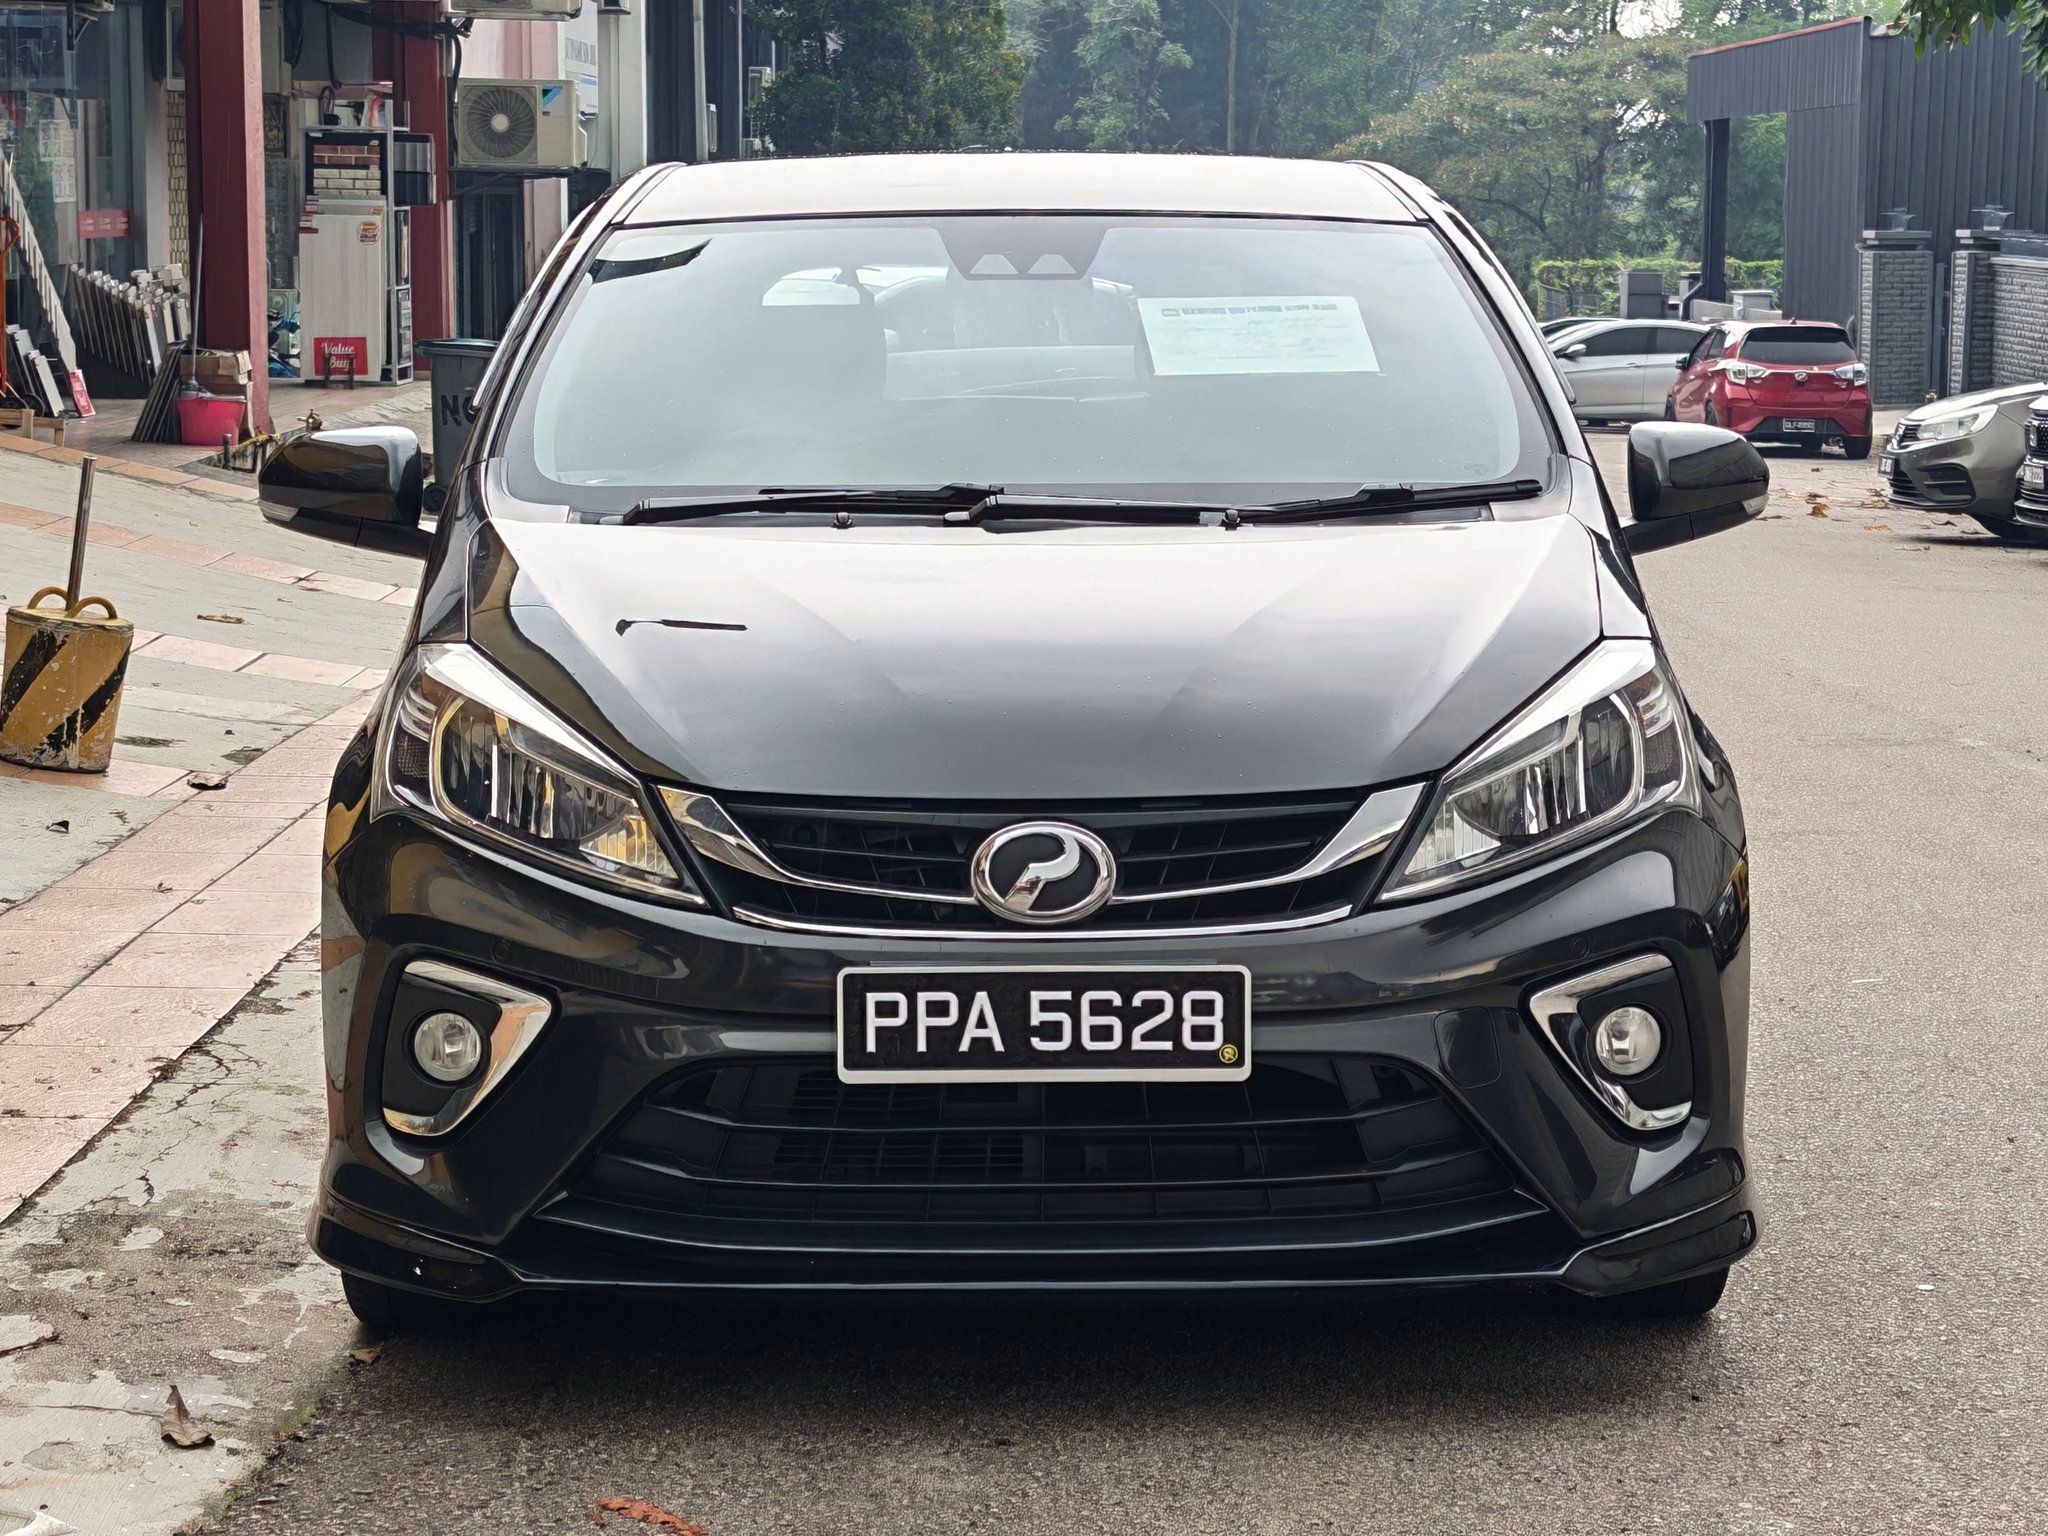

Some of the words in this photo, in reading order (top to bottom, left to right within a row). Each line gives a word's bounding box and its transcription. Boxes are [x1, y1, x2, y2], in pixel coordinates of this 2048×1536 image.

[321, 342, 356, 355] Value
[866, 991, 1005, 1053] PPA
[1030, 990, 1224, 1052] 5628
